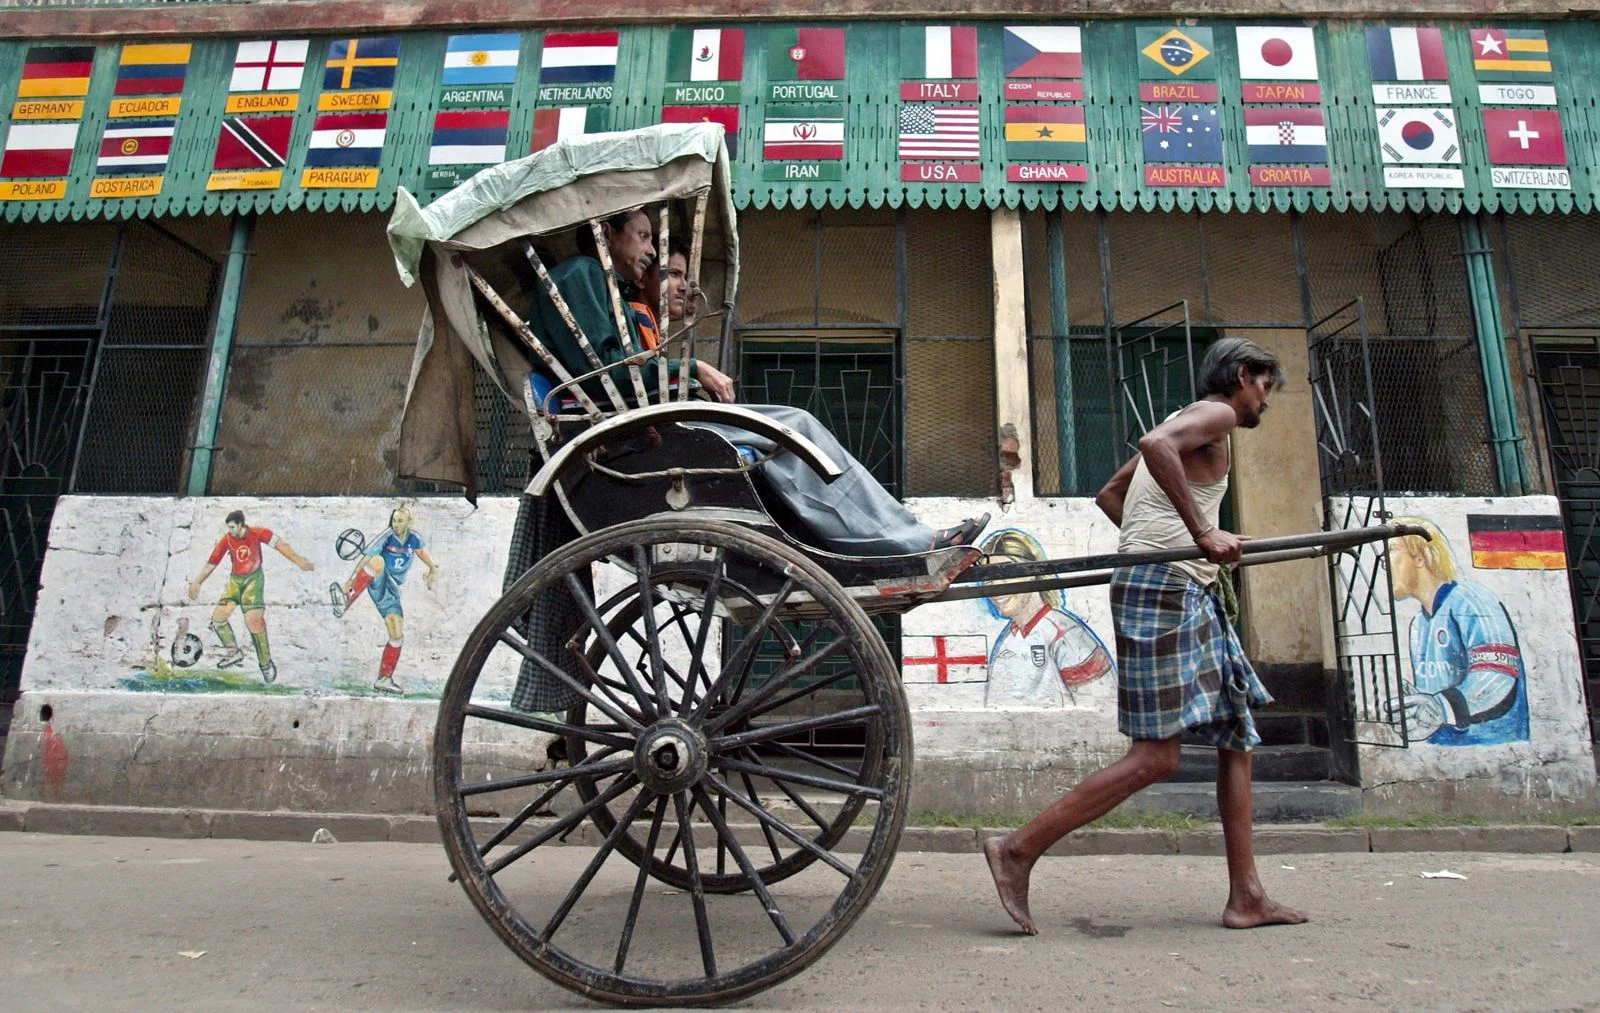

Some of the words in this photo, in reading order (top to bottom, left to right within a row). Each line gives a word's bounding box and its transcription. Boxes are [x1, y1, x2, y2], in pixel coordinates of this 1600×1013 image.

[442, 90, 504, 102] ARGENTINA
[539, 86, 612, 100] NETHERLANDS
[675, 87, 725, 101] MEXICO
[773, 86, 838, 98] PORTUGAL
[920, 84, 961, 98] ITALY
[1036, 91, 1072, 99] REPUBLIC
[1153, 86, 1200, 99] BRAZIL
[1256, 86, 1305, 99] JAPAN
[1387, 87, 1439, 100] FRANCE
[1498, 88, 1535, 100] TOGO
[119, 100, 169, 113] ECUADOR
[237, 96, 289, 108] ENGLAND
[331, 94, 380, 106] SWEDEN
[19, 103, 74, 114] GERMANY
[309, 171, 371, 184] PARAGUAY
[785, 165, 820, 178] IRAN
[920, 166, 958, 180] USA
[1019, 166, 1068, 179] GHANA
[1150, 169, 1220, 184] AUSTRALIA
[1260, 170, 1312, 182] CROATIA
[1493, 170, 1569, 186] SWITZERLAND
[12, 183, 57, 195] POLAND
[95, 180, 155, 193] COSTARICA
[239, 549, 248, 559] 7
[394, 557, 405, 569] 12
